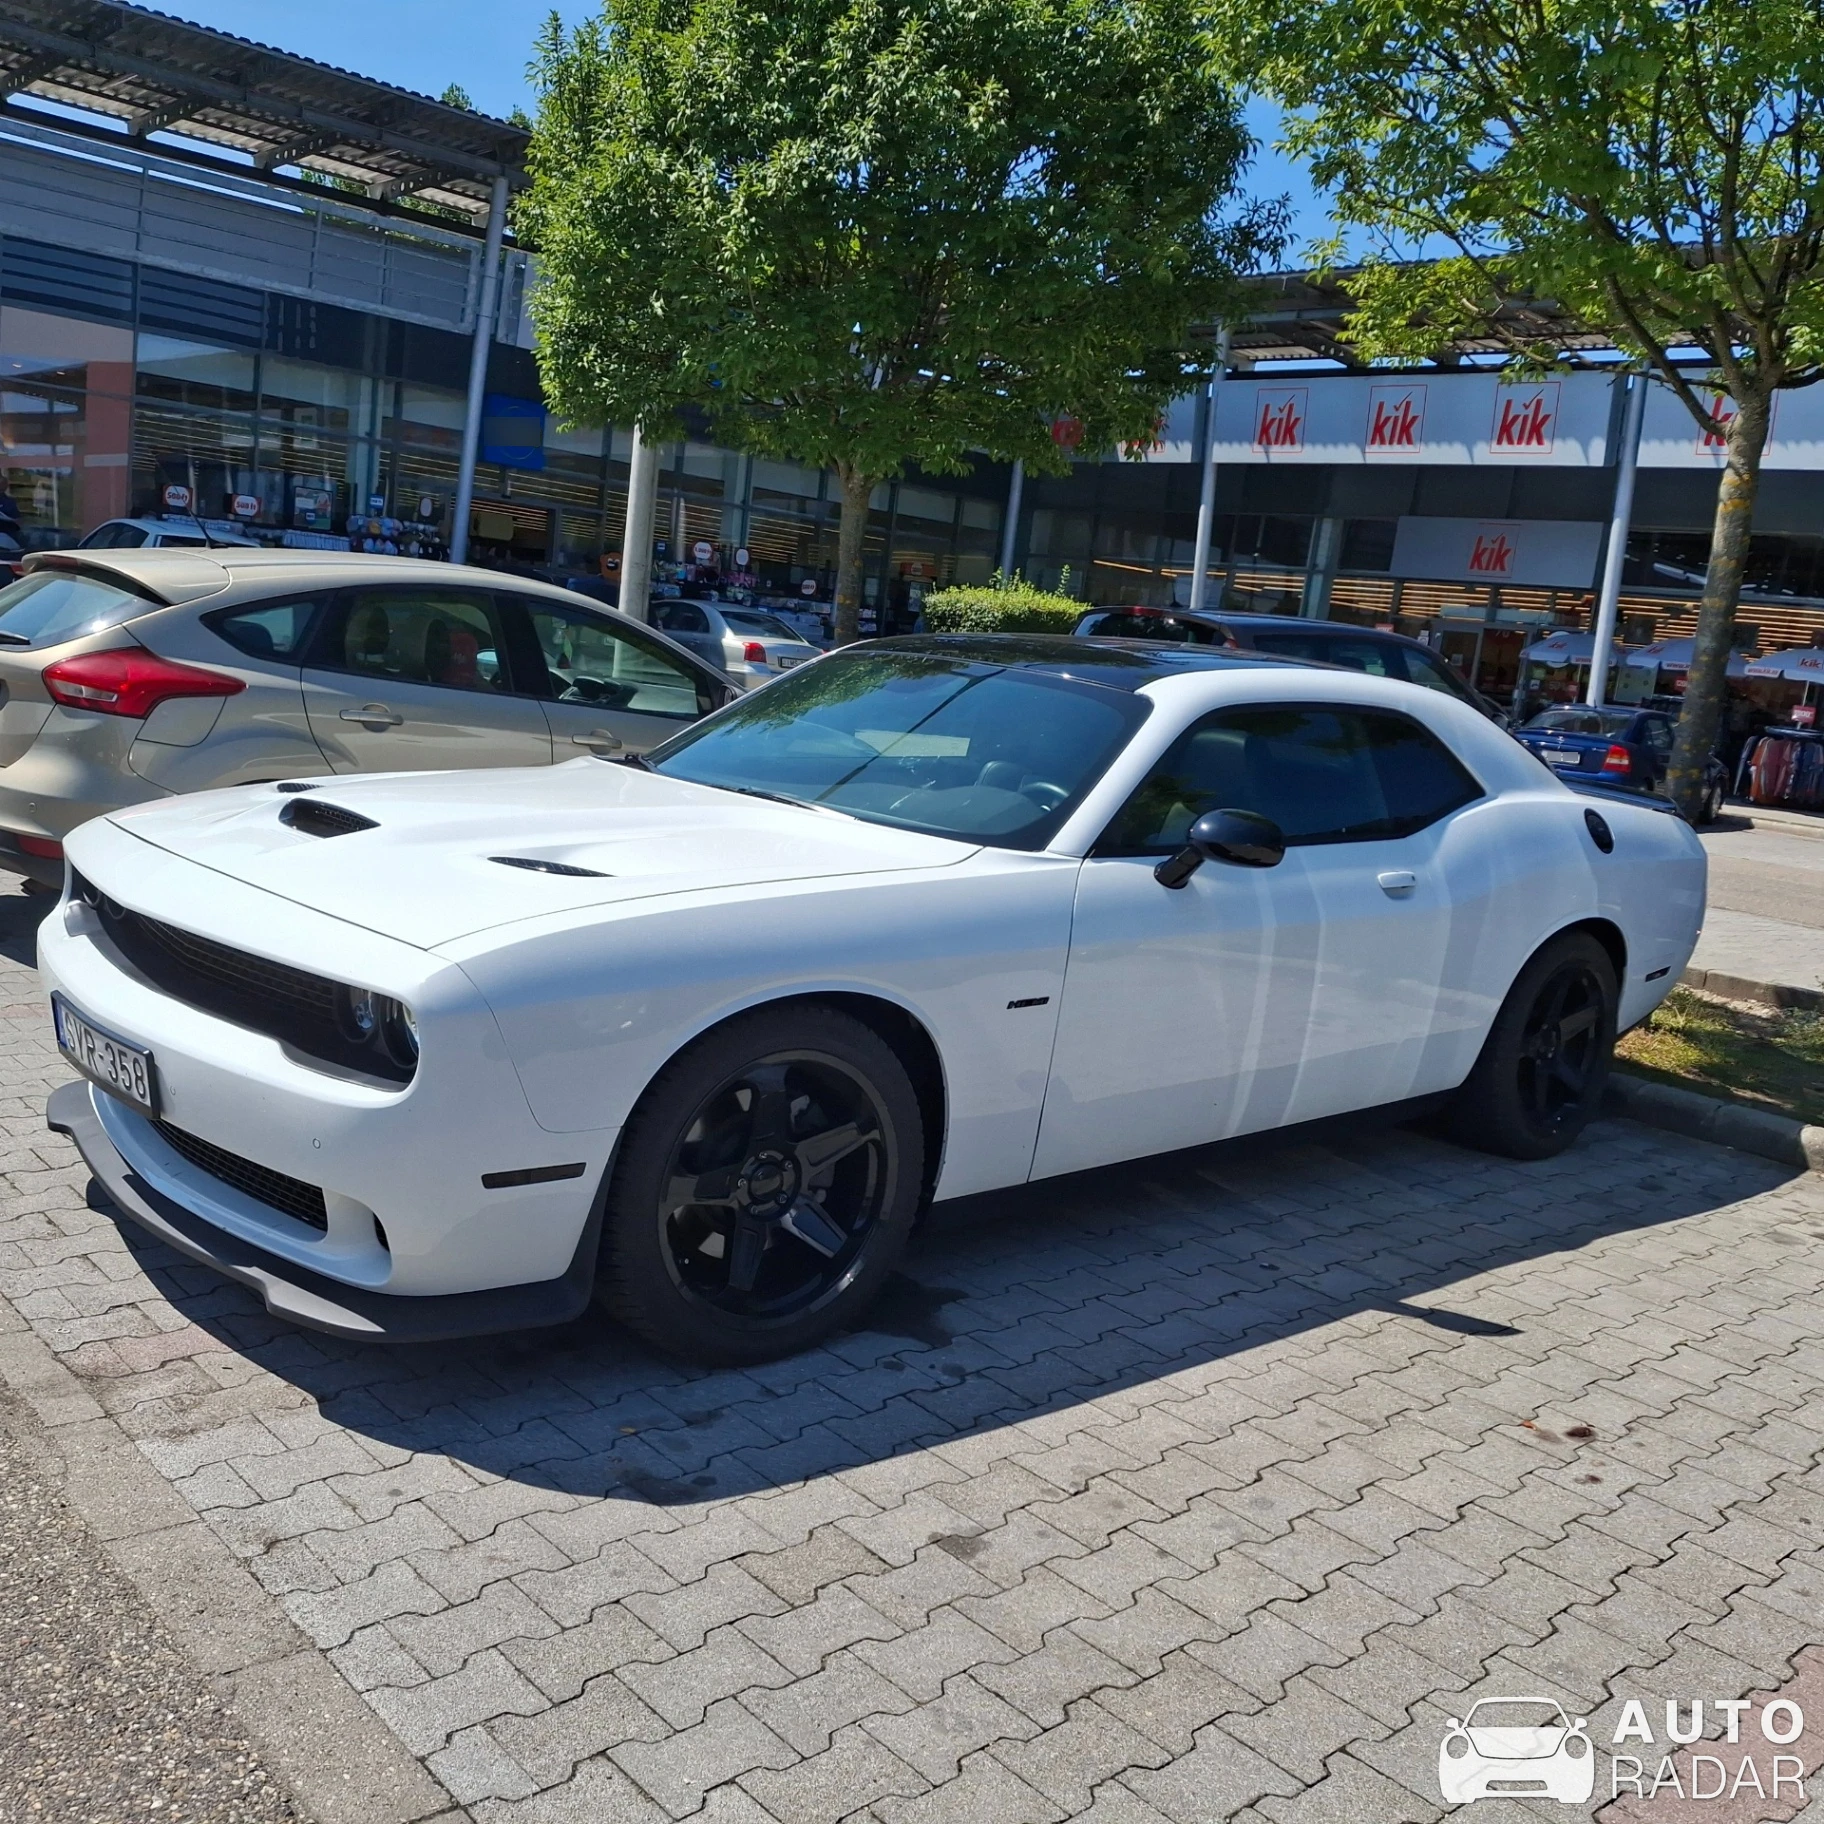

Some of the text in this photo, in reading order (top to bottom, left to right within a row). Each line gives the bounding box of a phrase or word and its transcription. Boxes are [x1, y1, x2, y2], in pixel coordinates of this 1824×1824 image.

[1257, 394, 1302, 446] kik
[1370, 392, 1420, 446] kik
[1496, 388, 1552, 446] kik
[1469, 533, 1512, 571] kik
[1800, 658, 1821, 669] kik
[65, 1012, 147, 1100] SYR-358
